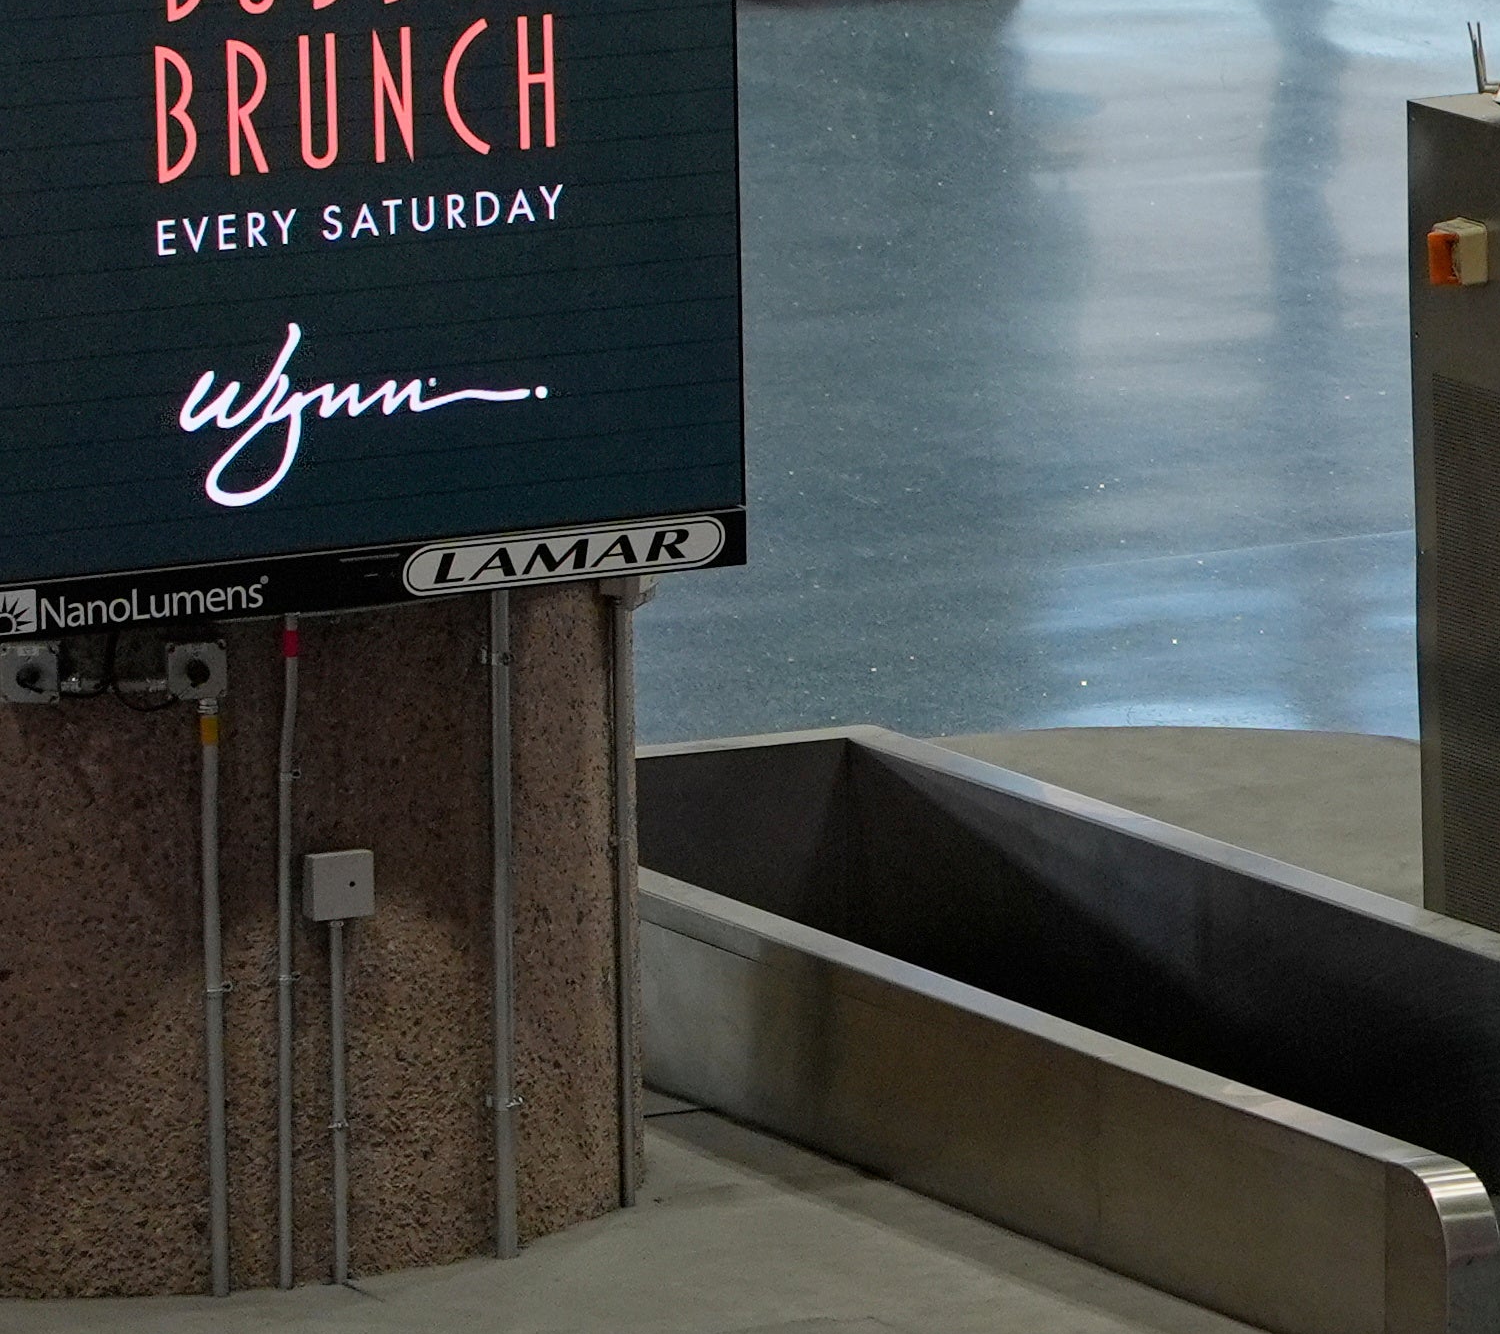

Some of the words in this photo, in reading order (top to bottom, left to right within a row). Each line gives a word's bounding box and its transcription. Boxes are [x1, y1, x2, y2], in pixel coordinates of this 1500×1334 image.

[154, 13, 558, 185] BRUNCH
[155, 209, 297, 257] EVERY
[321, 183, 565, 243] SATURDAY
[431, 524, 692, 586] LAMAR
